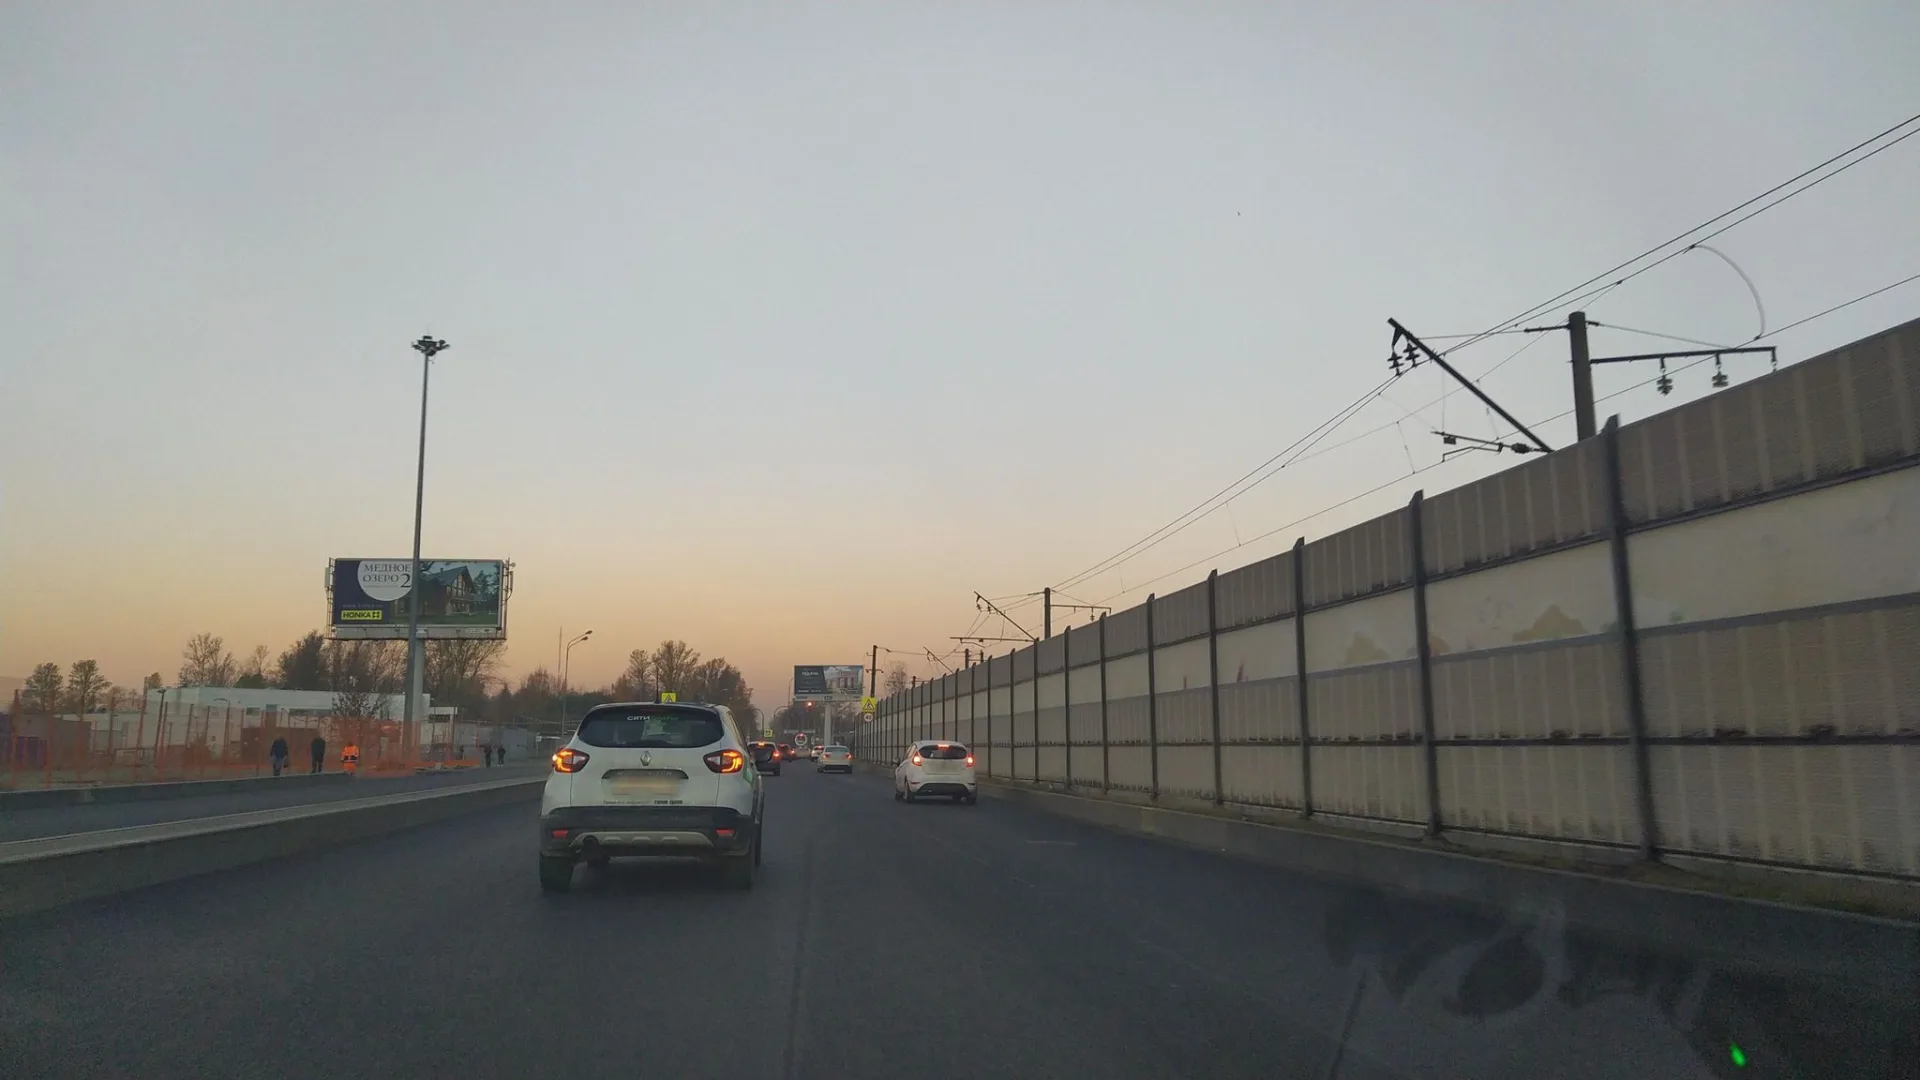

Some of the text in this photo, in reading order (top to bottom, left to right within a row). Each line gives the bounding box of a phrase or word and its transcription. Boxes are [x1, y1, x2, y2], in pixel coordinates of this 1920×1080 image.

[364, 563, 411, 572] МЕДНОЕ
[362, 573, 411, 588] ОЗЕРО 2
